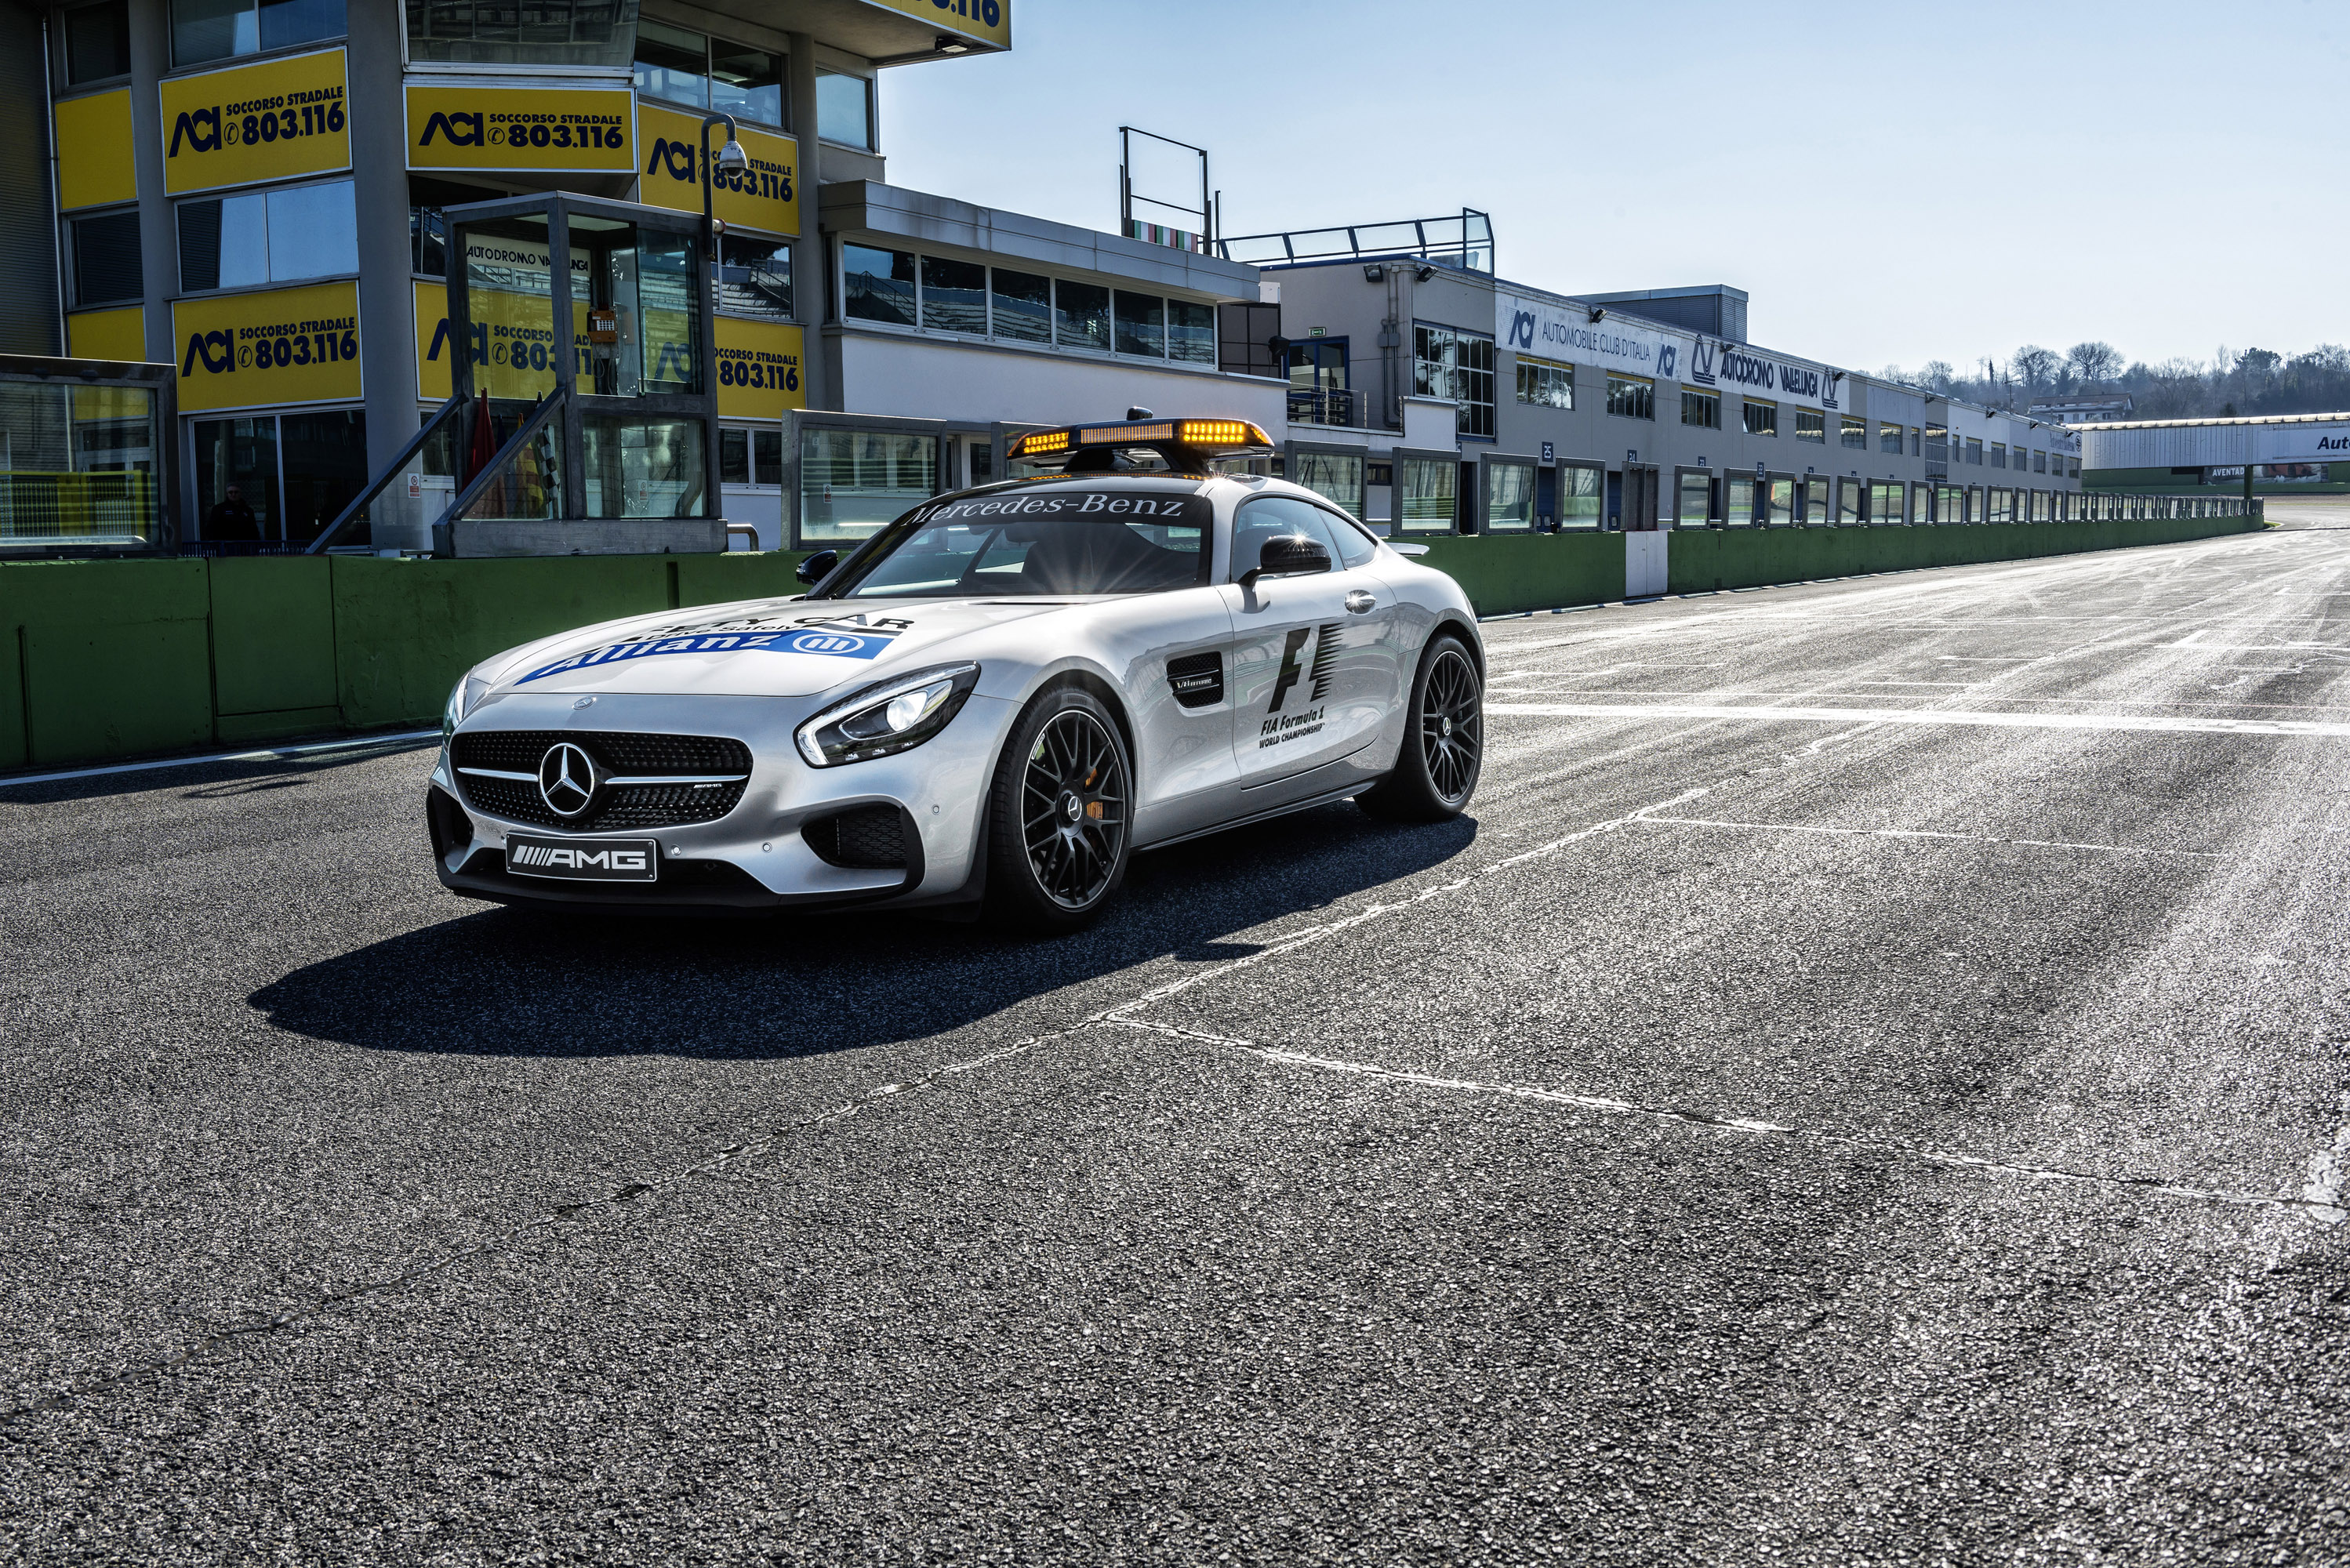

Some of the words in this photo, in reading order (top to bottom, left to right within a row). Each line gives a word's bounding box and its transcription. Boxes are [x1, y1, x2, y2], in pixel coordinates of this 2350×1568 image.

[226, 96, 284, 116] SOCCORSO
[287, 85, 343, 106] STRADALE
[169, 106, 222, 158] ACI
[242, 101, 345, 146] 803.116
[418, 111, 485, 147] ACI
[489, 113, 557, 124] SOCCORSO
[561, 114, 623, 125] STRADALE
[508, 125, 623, 149] 803.116
[647, 137, 696, 184] ACI
[750, 158, 792, 176] STRADALE
[713, 163, 793, 202] 803.116
[467, 245, 536, 265] AUTODROMO
[239, 323, 296, 339] SOCCORSO
[300, 317, 355, 333] STRADALE
[493, 325, 553, 342] SOCCORSO
[181, 328, 236, 377] ACI
[255, 329, 358, 369] 803.116
[756, 351, 797, 365] STRADALE
[1509, 310, 1536, 349] ACI
[1542, 321, 1597, 351] AUTOMOBILE
[1600, 333, 1619, 355] CLUB
[1622, 339, 1651, 362] D'ITALIA
[1657, 343, 1676, 377] ACI
[720, 360, 798, 392] 803.116
[1720, 352, 1774, 390] AUTODROMO
[1779, 365, 1818, 398] VALLELUNGA
[1544, 445, 1552, 459] 25
[2317, 436, 2350, 450] Aut
[2212, 467, 2245, 477] AVENTAD
[900, 493, 1186, 527] Mercedes-Benz
[794, 614, 916, 630] CAR
[536, 633, 782, 677] Allianz
[1261, 717, 1279, 736] FIA
[1280, 707, 1317, 731] Formula
[1318, 706, 1325, 720] 1
[1259, 735, 1280, 750] WORLD
[547, 849, 646, 869] AMG
